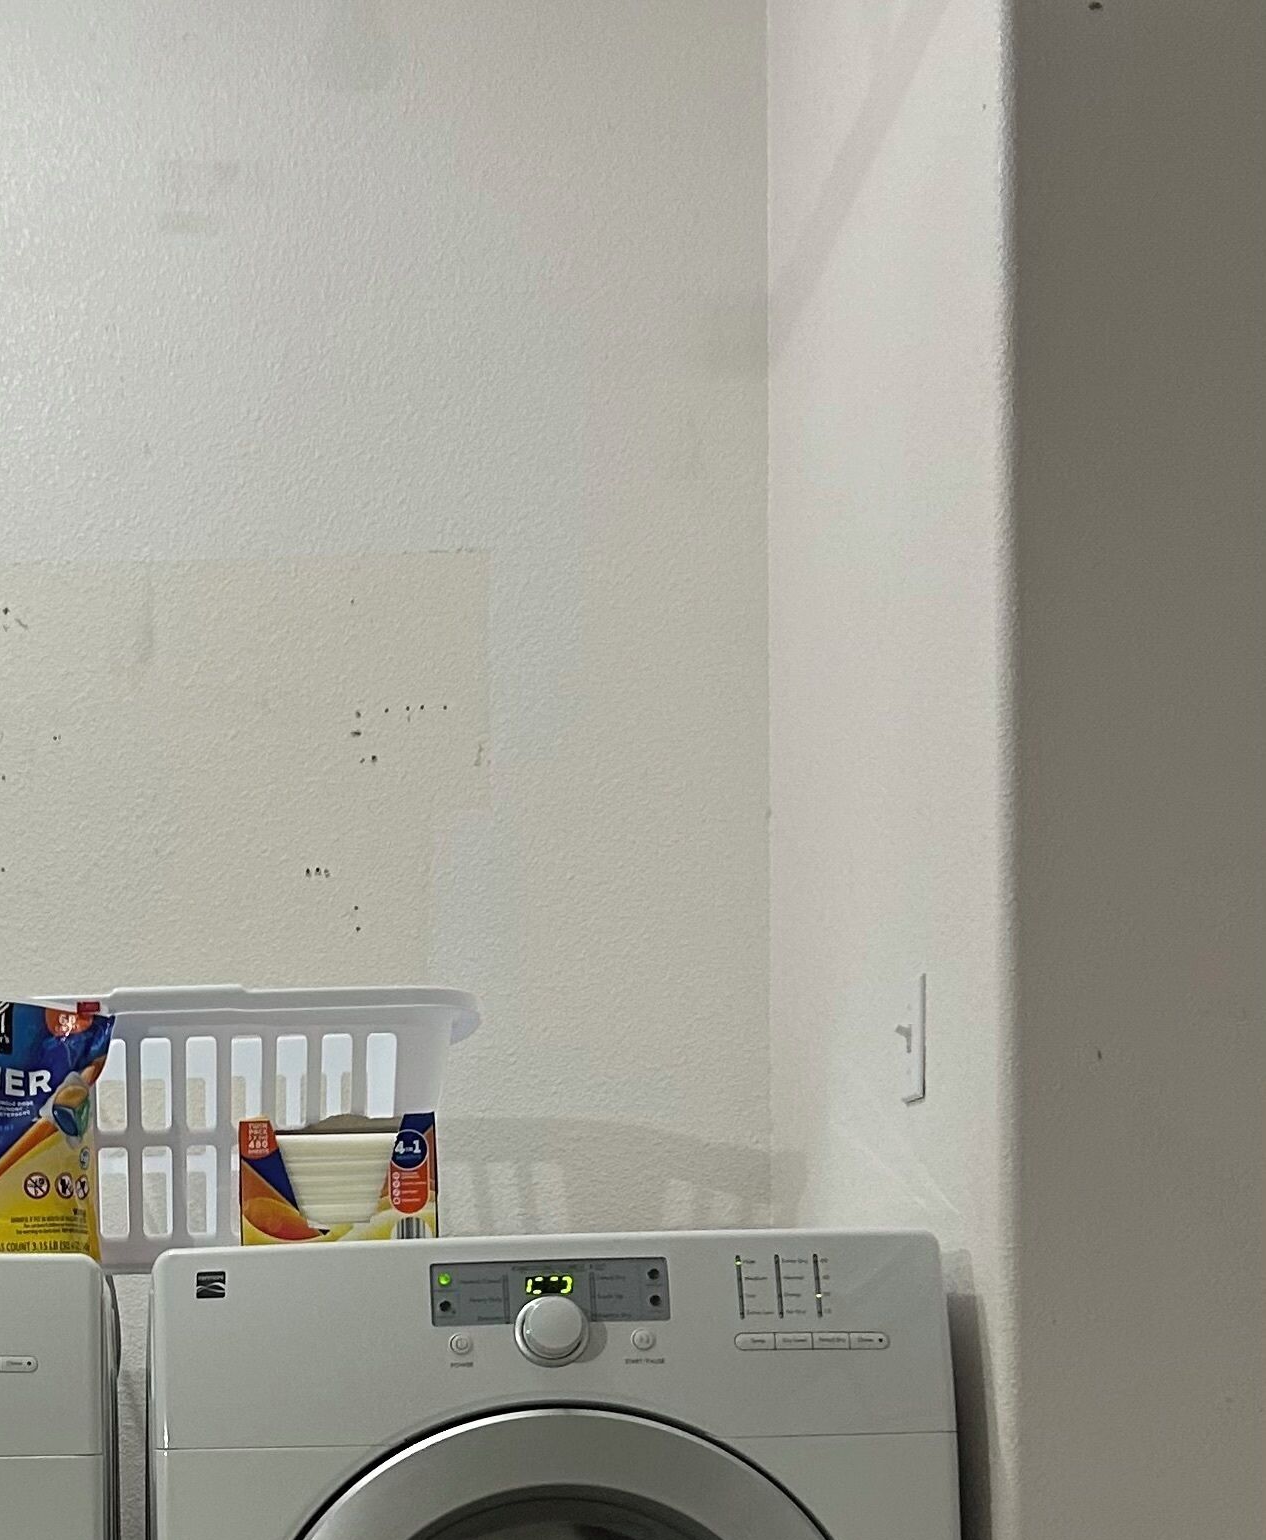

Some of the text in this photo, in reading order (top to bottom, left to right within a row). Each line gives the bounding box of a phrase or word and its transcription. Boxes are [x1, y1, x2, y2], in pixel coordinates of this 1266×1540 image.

[394, 1140, 406, 1154] 4
[413, 1139, 422, 1153] 1
[6, 1240, 31, 1253] COUNT
